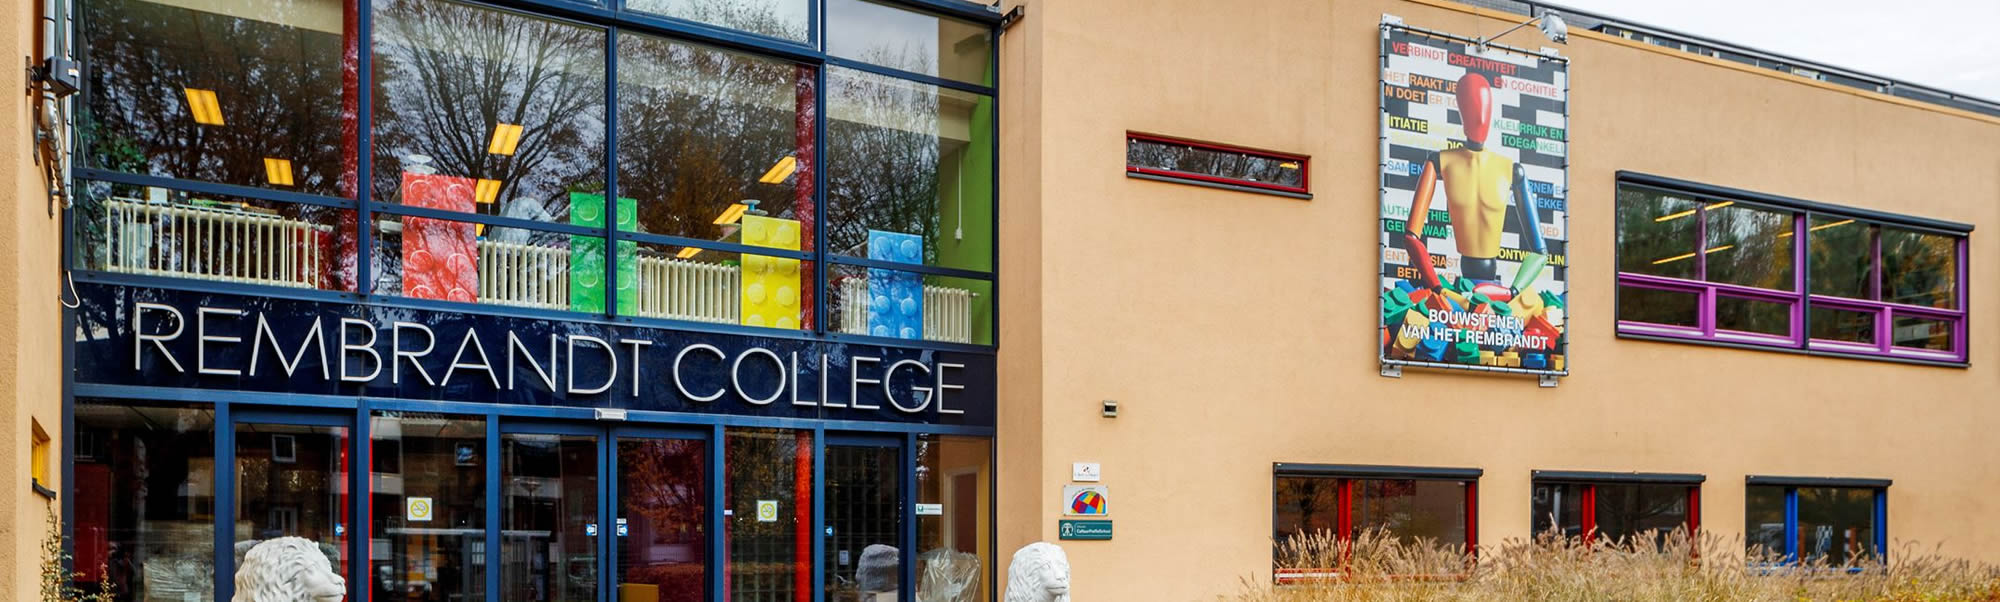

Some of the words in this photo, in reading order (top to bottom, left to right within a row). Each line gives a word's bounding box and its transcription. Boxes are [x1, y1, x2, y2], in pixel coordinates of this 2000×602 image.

[1392, 42, 1446, 61] VERBINDT
[1449, 54, 1516, 75] CREATIVITEIT
[1409, 74, 1443, 90] RAAKT
[1493, 76, 1508, 88] EN
[1511, 79, 1558, 97] COGNITIE
[1396, 87, 1426, 103] DOET
[1428, 93, 1443, 105] ER
[1494, 119, 1548, 138] KLEURRIJK
[1550, 128, 1564, 140] EN
[1428, 308, 1525, 331] BOUWSTENEN
[1401, 324, 1430, 340] VAN
[1434, 327, 1462, 343] HET
[1465, 331, 1549, 350] REMBRANDT
[134, 301, 653, 398] REMBRANDT
[672, 342, 966, 415] COLLEGE
